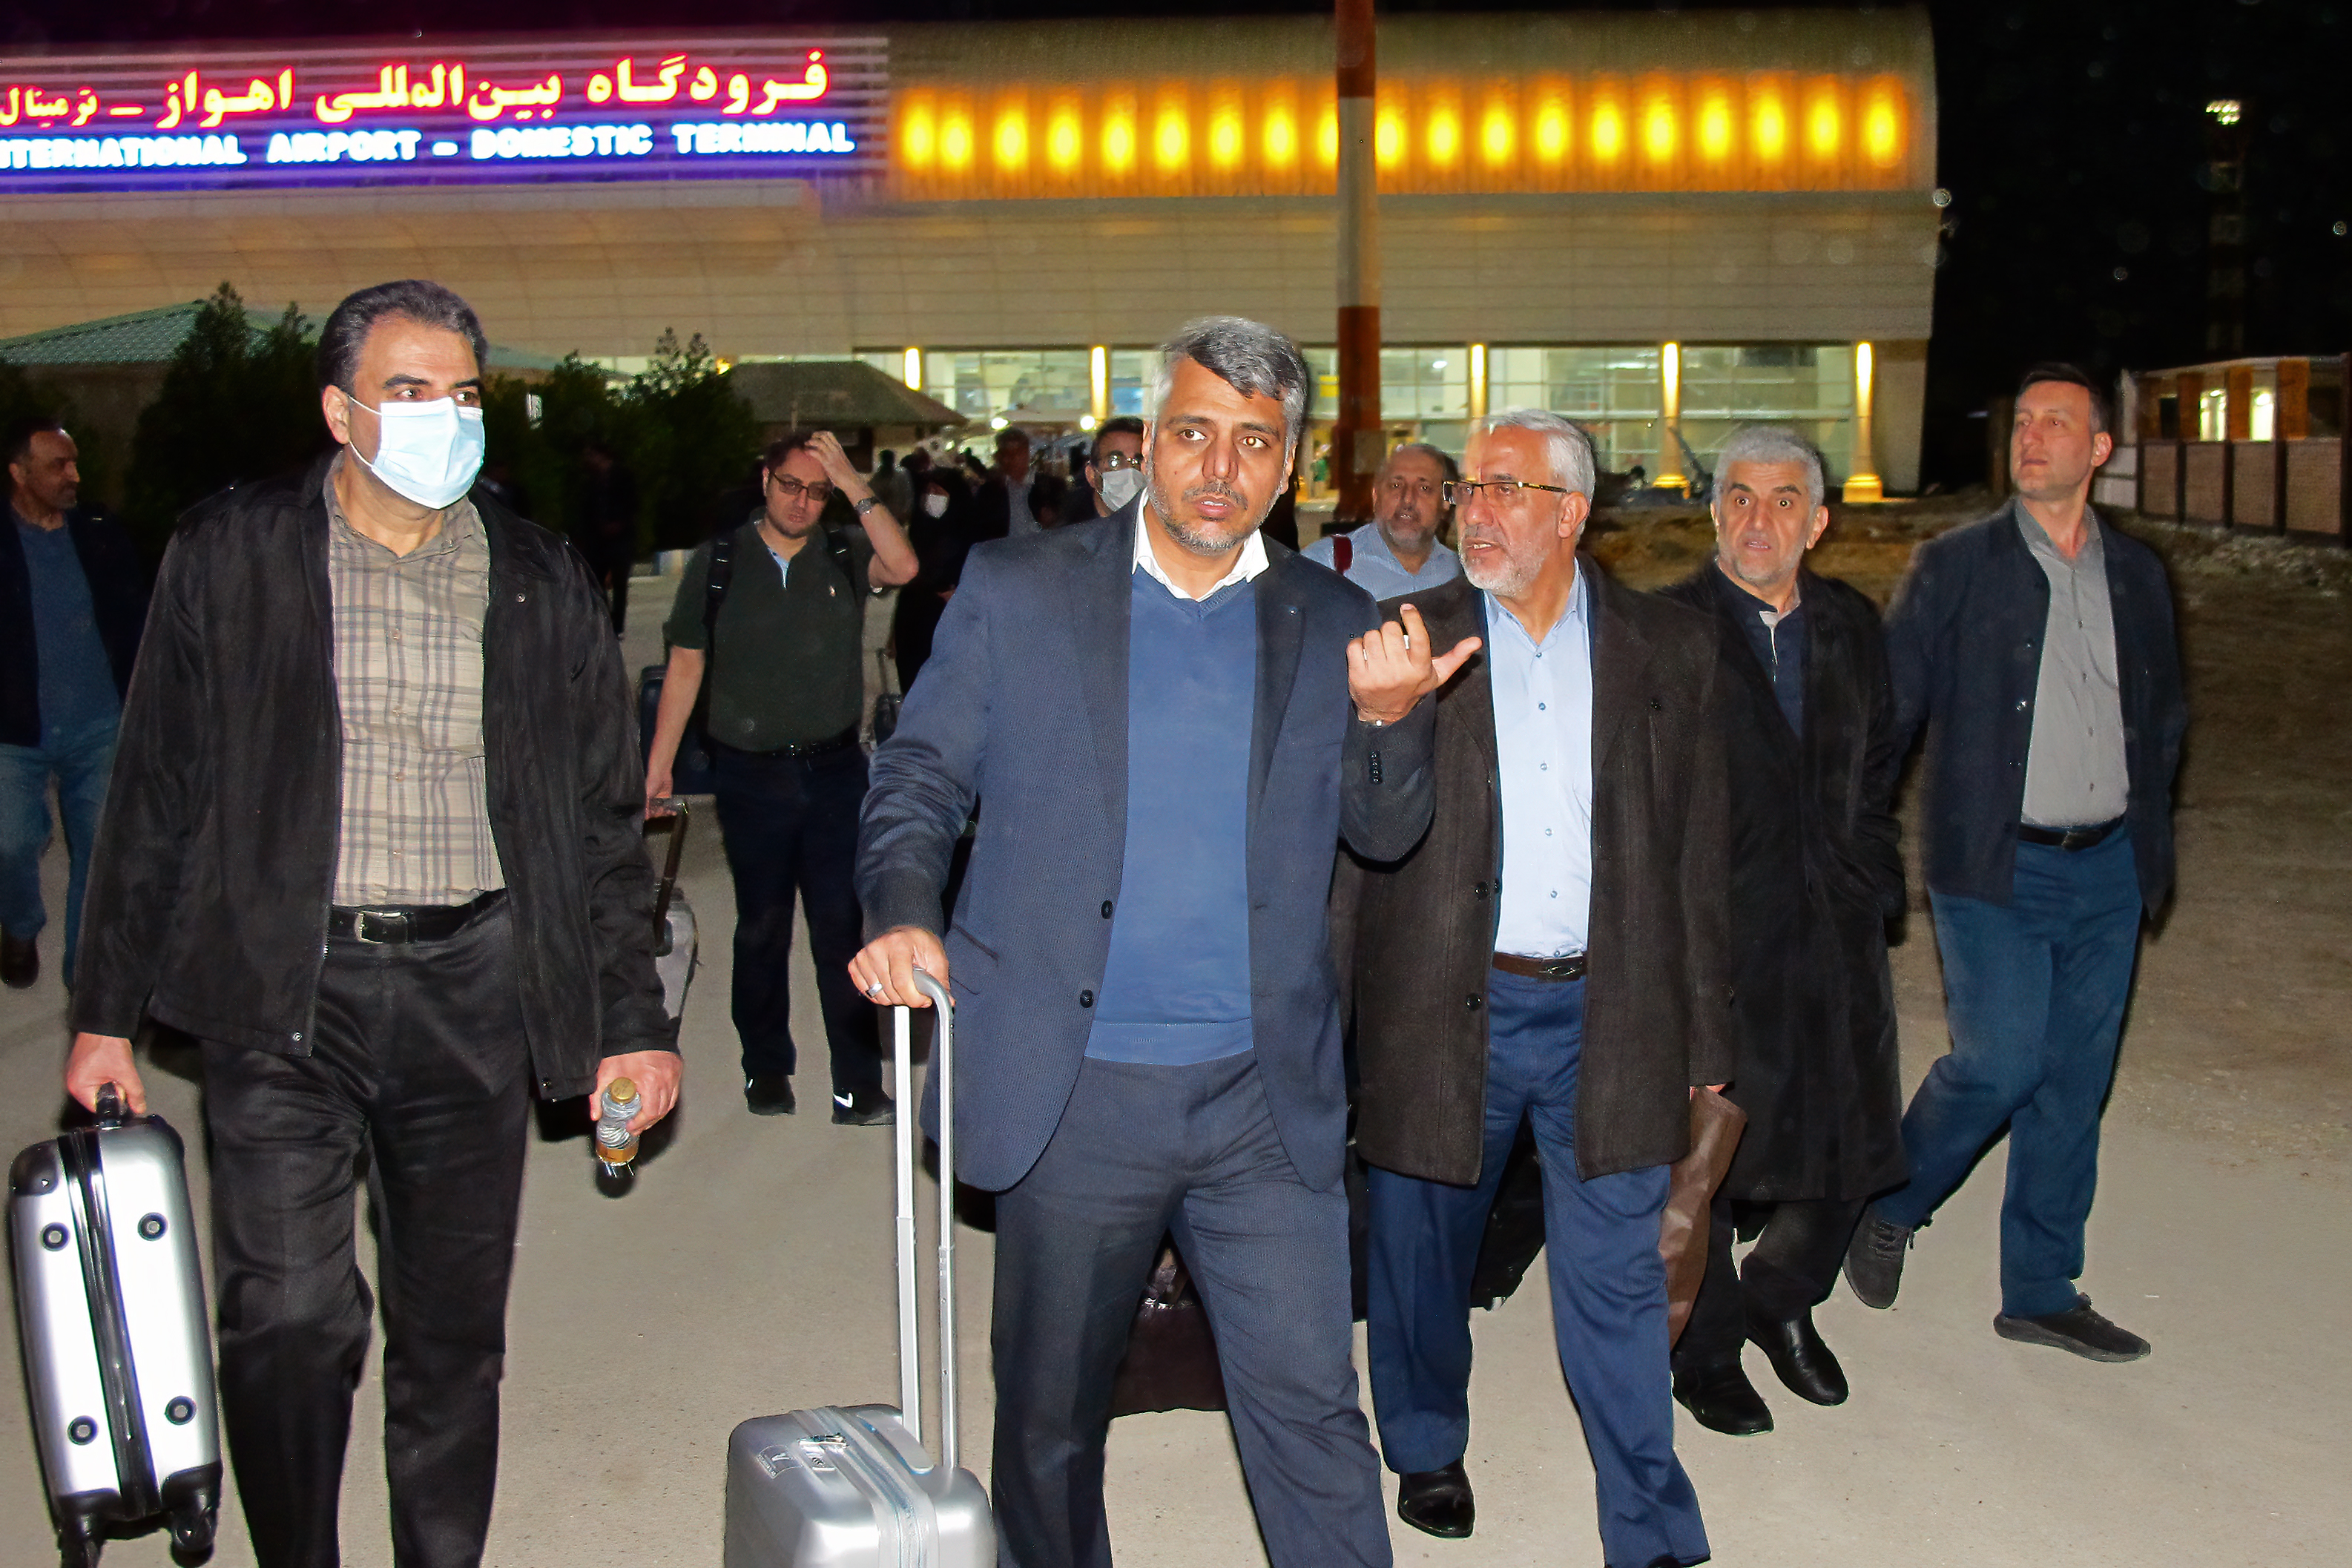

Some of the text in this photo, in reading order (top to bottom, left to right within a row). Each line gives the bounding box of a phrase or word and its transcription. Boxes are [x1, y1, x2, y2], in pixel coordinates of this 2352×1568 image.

[154, 67, 294, 131] اهواز
[584, 49, 829, 116] فرودگاه
[266, 129, 422, 164] AIRPORT
[470, 123, 653, 160] DOMESTIC
[671, 122, 856, 154] TERMINAL
